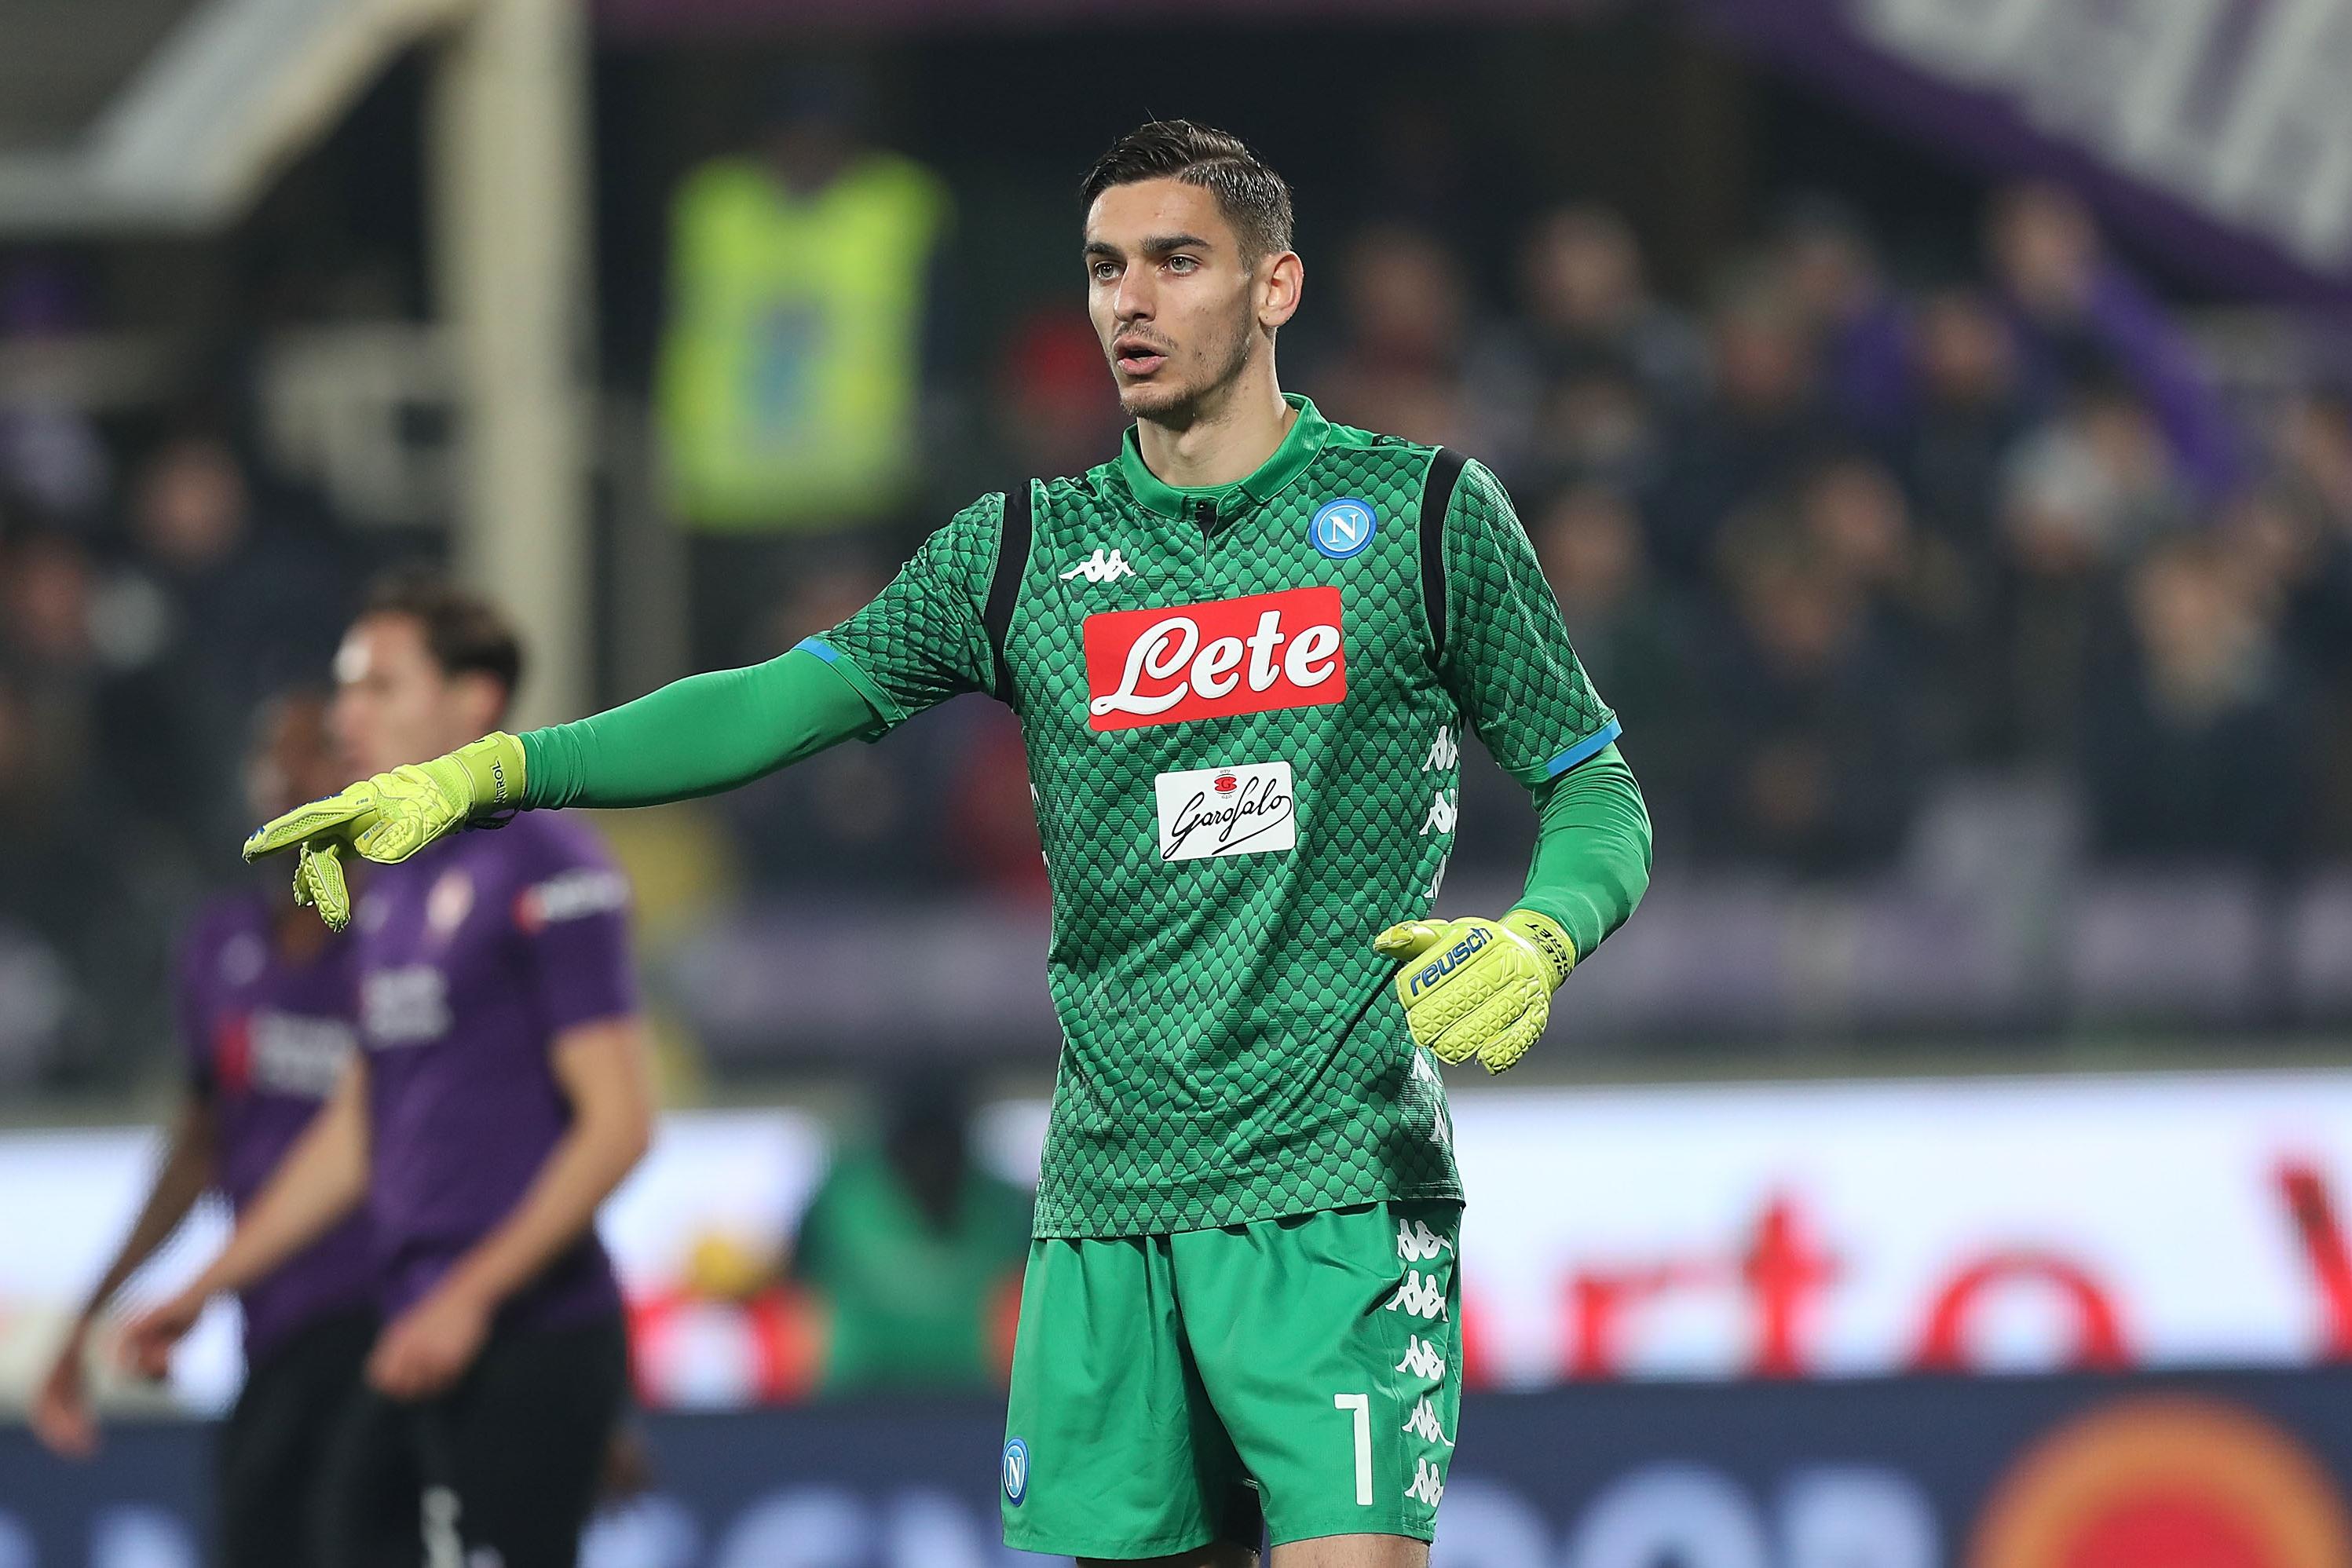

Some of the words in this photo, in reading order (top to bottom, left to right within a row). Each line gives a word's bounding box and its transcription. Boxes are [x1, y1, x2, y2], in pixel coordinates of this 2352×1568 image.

[1329, 513, 1359, 543] N
[1090, 609, 1341, 716] Lete
[1162, 776, 1293, 860] Garofalo
[1410, 927, 1493, 996] reusch
[1008, 1457, 1022, 1489] N
[1333, 1392, 1374, 1506] 1
